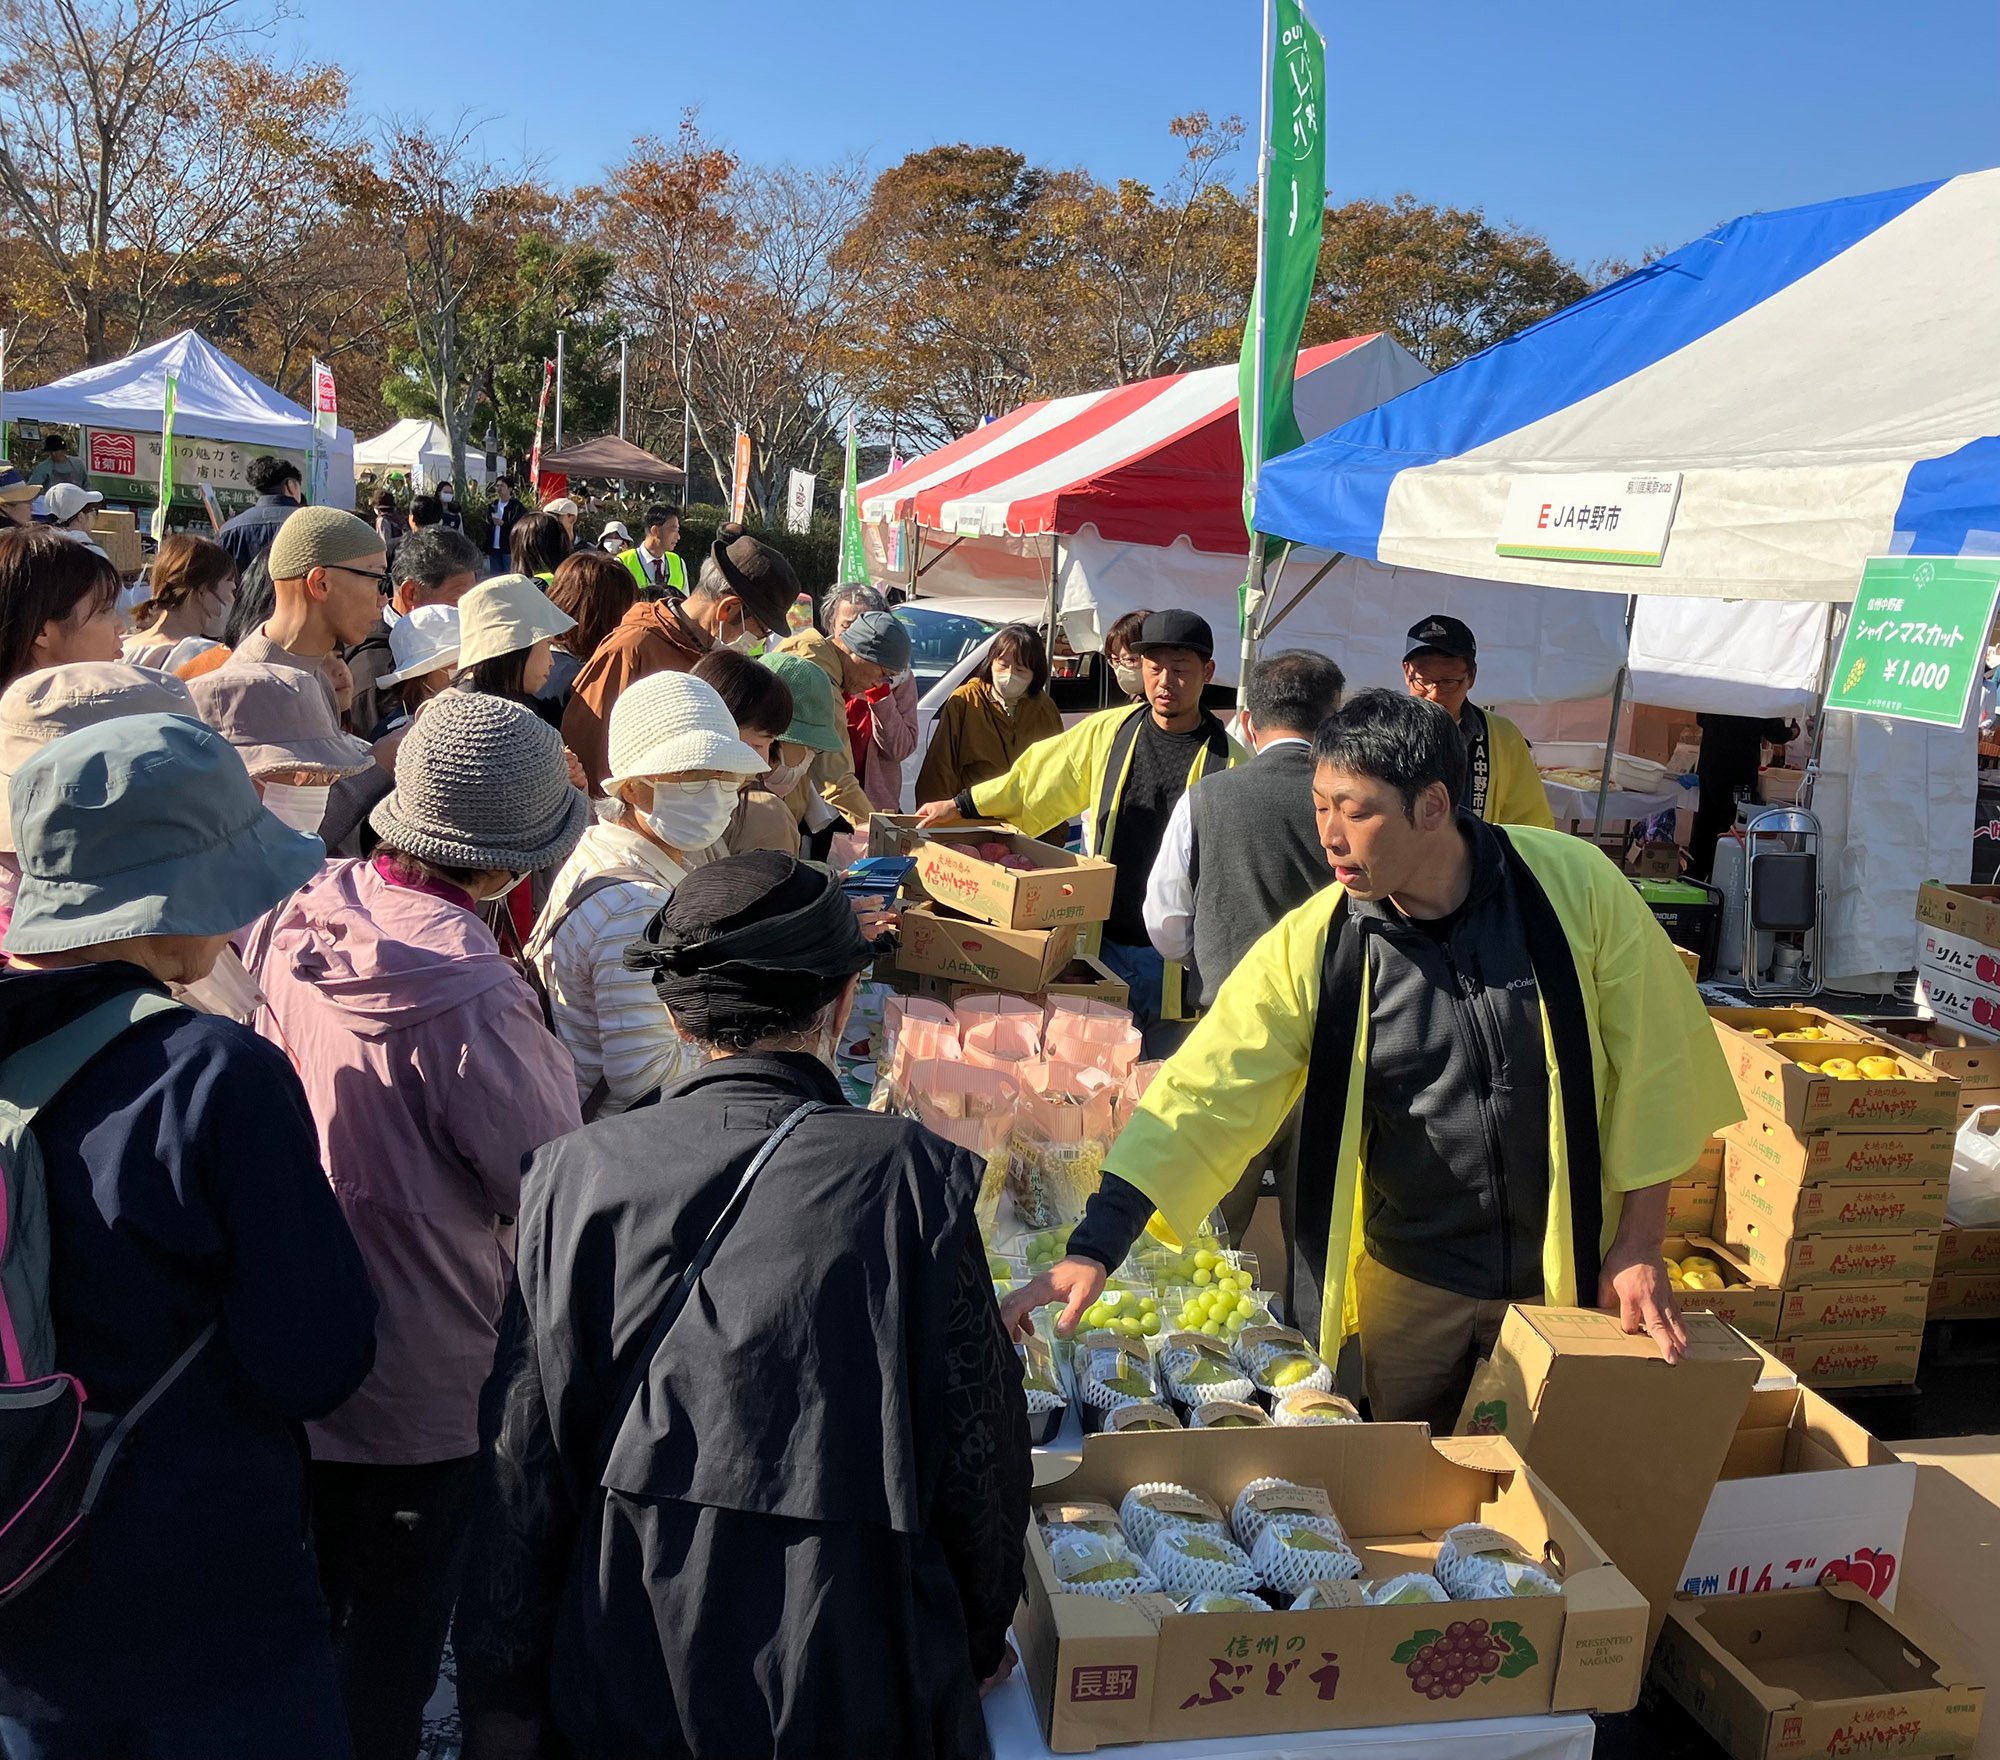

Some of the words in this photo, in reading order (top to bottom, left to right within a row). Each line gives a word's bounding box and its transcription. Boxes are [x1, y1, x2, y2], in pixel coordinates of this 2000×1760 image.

[1537, 503, 1552, 529] E
[1553, 504, 1622, 532] JA中野市
[1866, 597, 1905, 612] 信州中野産
[1855, 618, 1965, 649] シャインマスカット
[1882, 657, 1950, 692] ¥1,000
[924, 861, 980, 901] 信州中野
[1041, 904, 1086, 923] JA中野市
[937, 956, 1000, 981] JA中野市
[1935, 946, 1979, 969] りんご
[1931, 987, 1975, 1011] りんご
[1750, 1082, 1784, 1112] JA中野市
[1848, 1097, 1918, 1119] 信州中野
[1747, 1137, 1782, 1165] JA中野市
[1845, 1151, 1915, 1172] 信州中野
[1739, 1186, 1774, 1216] JA中野市
[1839, 1203, 1905, 1223] 信州中野
[1735, 1236, 1767, 1266] JA中野市
[1828, 1253, 1897, 1274] 信州中野
[1819, 1304, 1889, 1326] 信州中野
[1811, 1354, 1880, 1375] 信州中野
[1683, 1574, 1719, 1596] 信州
[1727, 1556, 1818, 1595] りんご
[1223, 1634, 1306, 1659] 信州の
[1575, 1635, 1633, 1649] PRESENTED
[1595, 1647, 1609, 1656] BY
[1579, 1654, 1624, 1667] NAGANO
[1075, 1669, 1132, 1697] 長野
[1179, 1651, 1341, 1710] ぶどう
[1852, 1707, 1909, 1724] 大地の恵み
[1826, 1719, 1922, 1758] 信州中野
